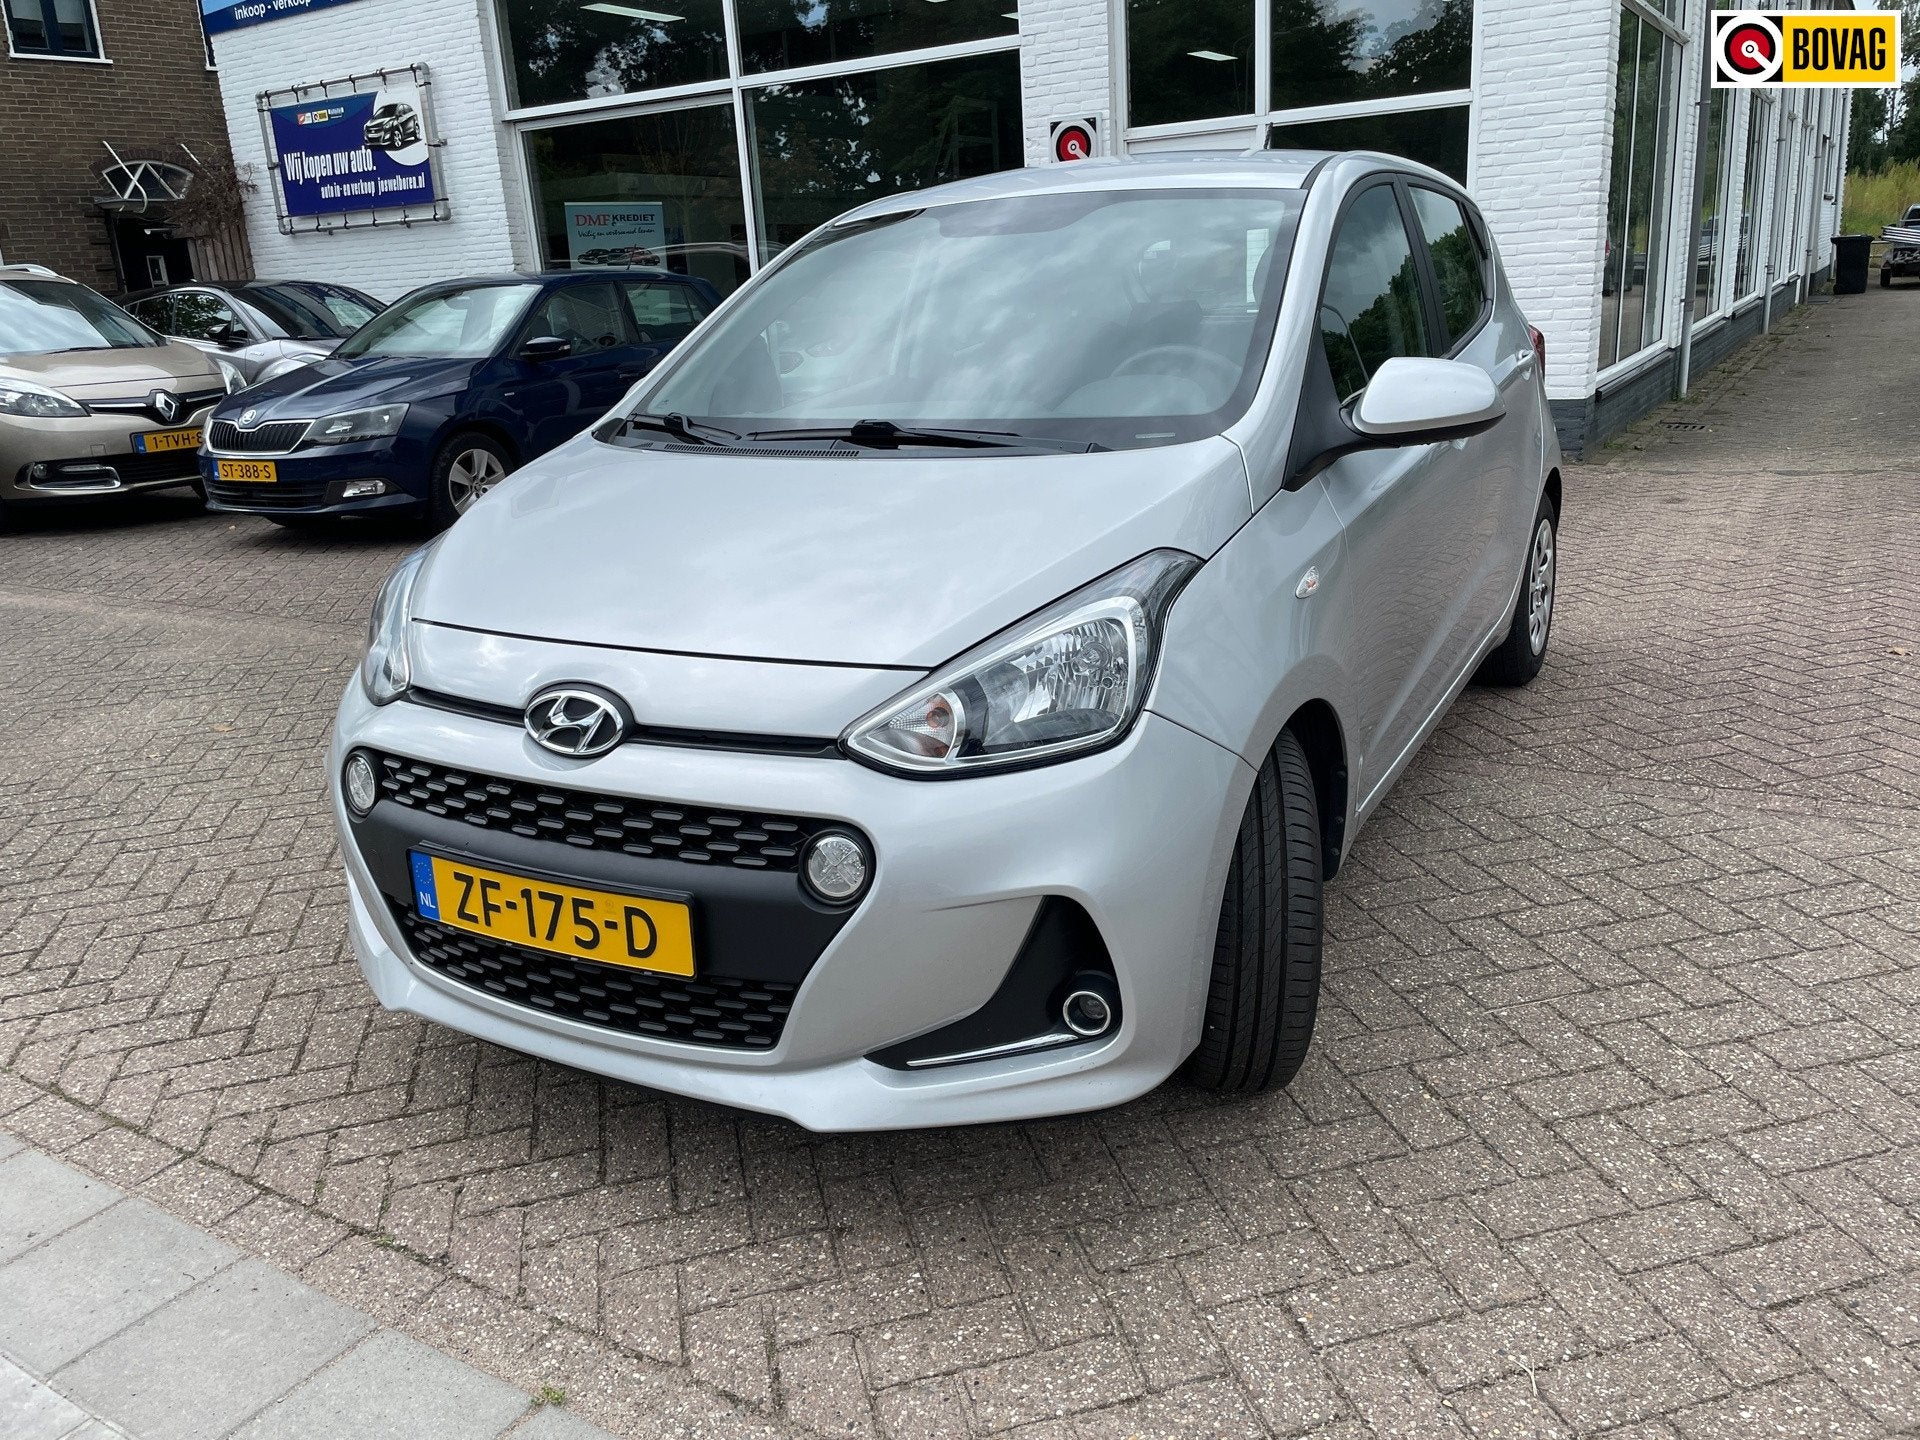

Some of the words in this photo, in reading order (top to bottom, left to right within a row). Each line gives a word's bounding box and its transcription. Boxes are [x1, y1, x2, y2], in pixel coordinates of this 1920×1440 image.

[234, 3, 266, 20] inkoop
[283, 152, 303, 185] Wij
[302, 151, 333, 183] kopen
[333, 151, 349, 175] uw
[350, 145, 377, 173] auto.
[351, 179, 376, 196] verkoop
[575, 214, 610, 226] DMF
[612, 213, 656, 222] KREDIET
[221, 463, 272, 479] ST-388-S
[419, 891, 436, 910] NL
[453, 871, 658, 959] ZF-175-D
